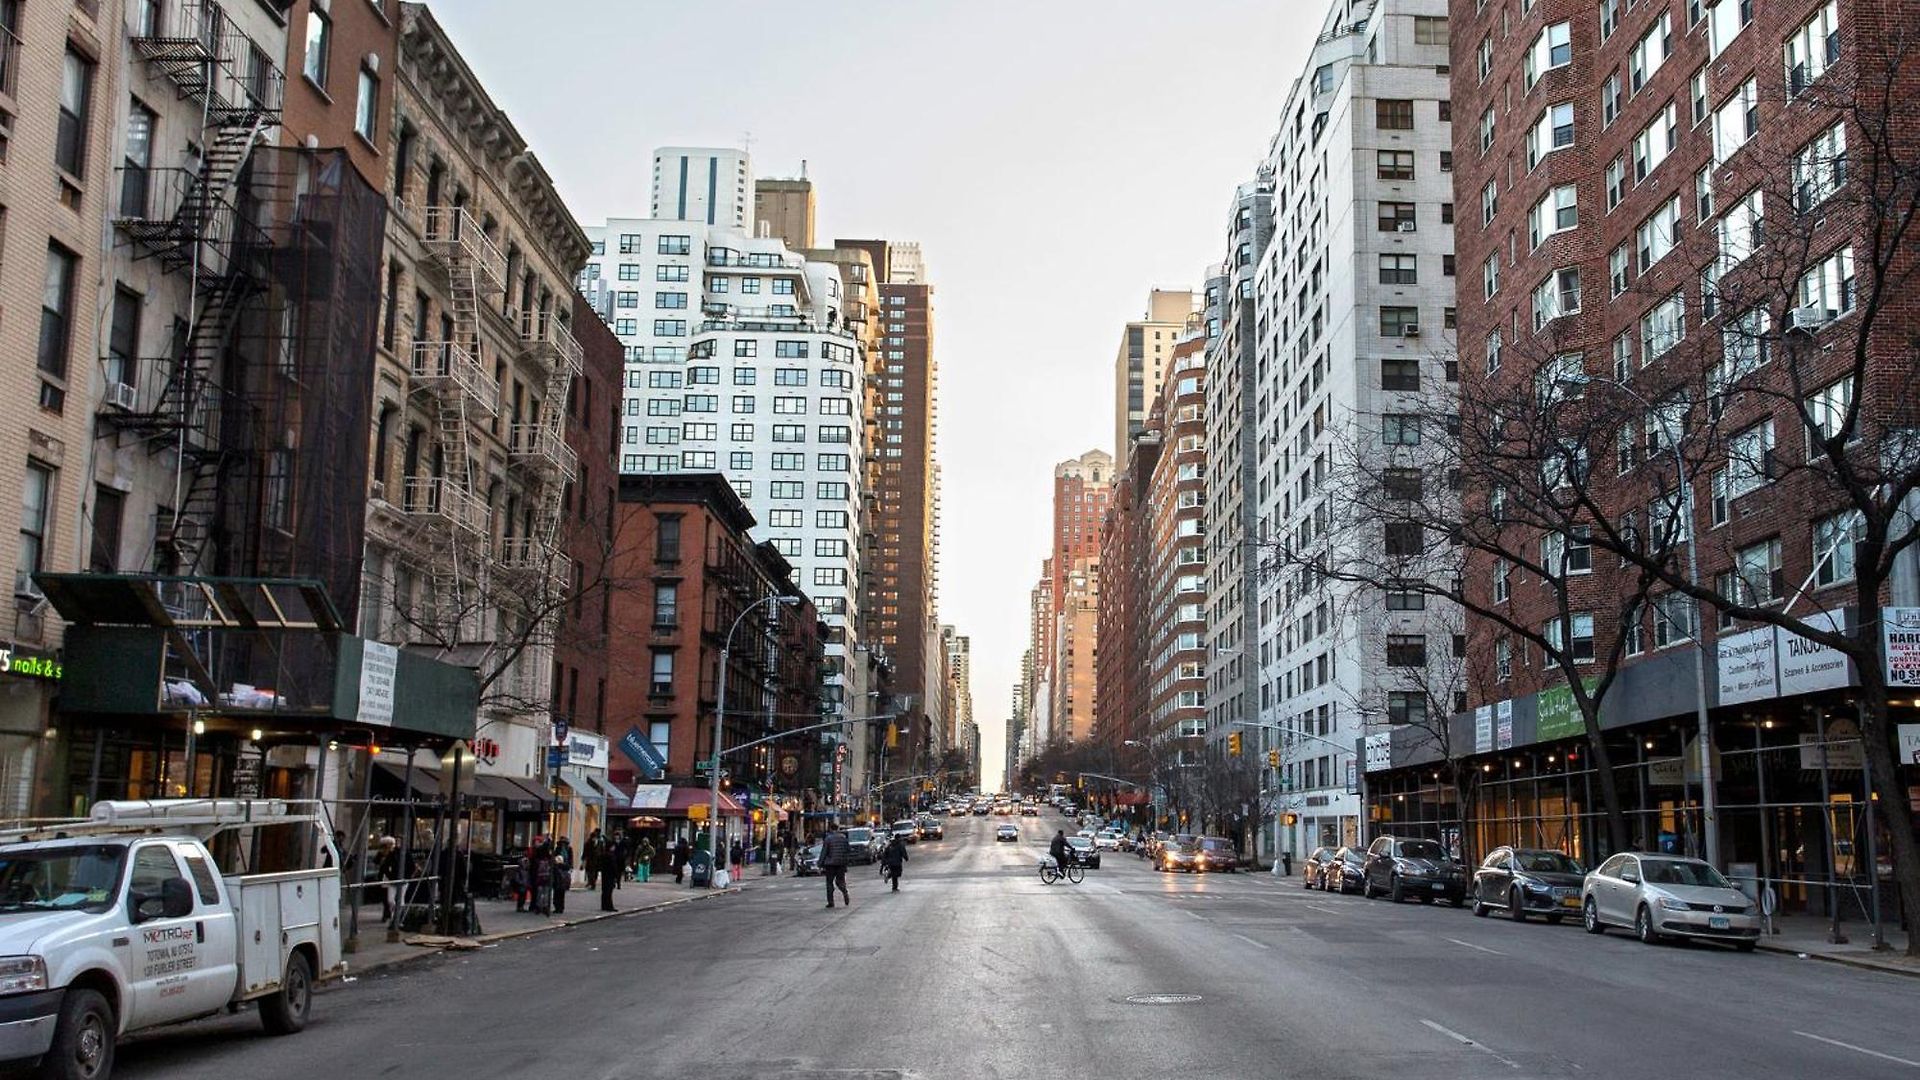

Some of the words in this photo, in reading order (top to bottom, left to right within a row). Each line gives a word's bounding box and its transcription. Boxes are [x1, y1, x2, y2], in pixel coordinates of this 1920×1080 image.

[1787, 637, 1831, 657] TANJO
[14, 657, 42, 675] nails
[44, 659, 53, 677] &
[1891, 669, 1905, 682] NO
